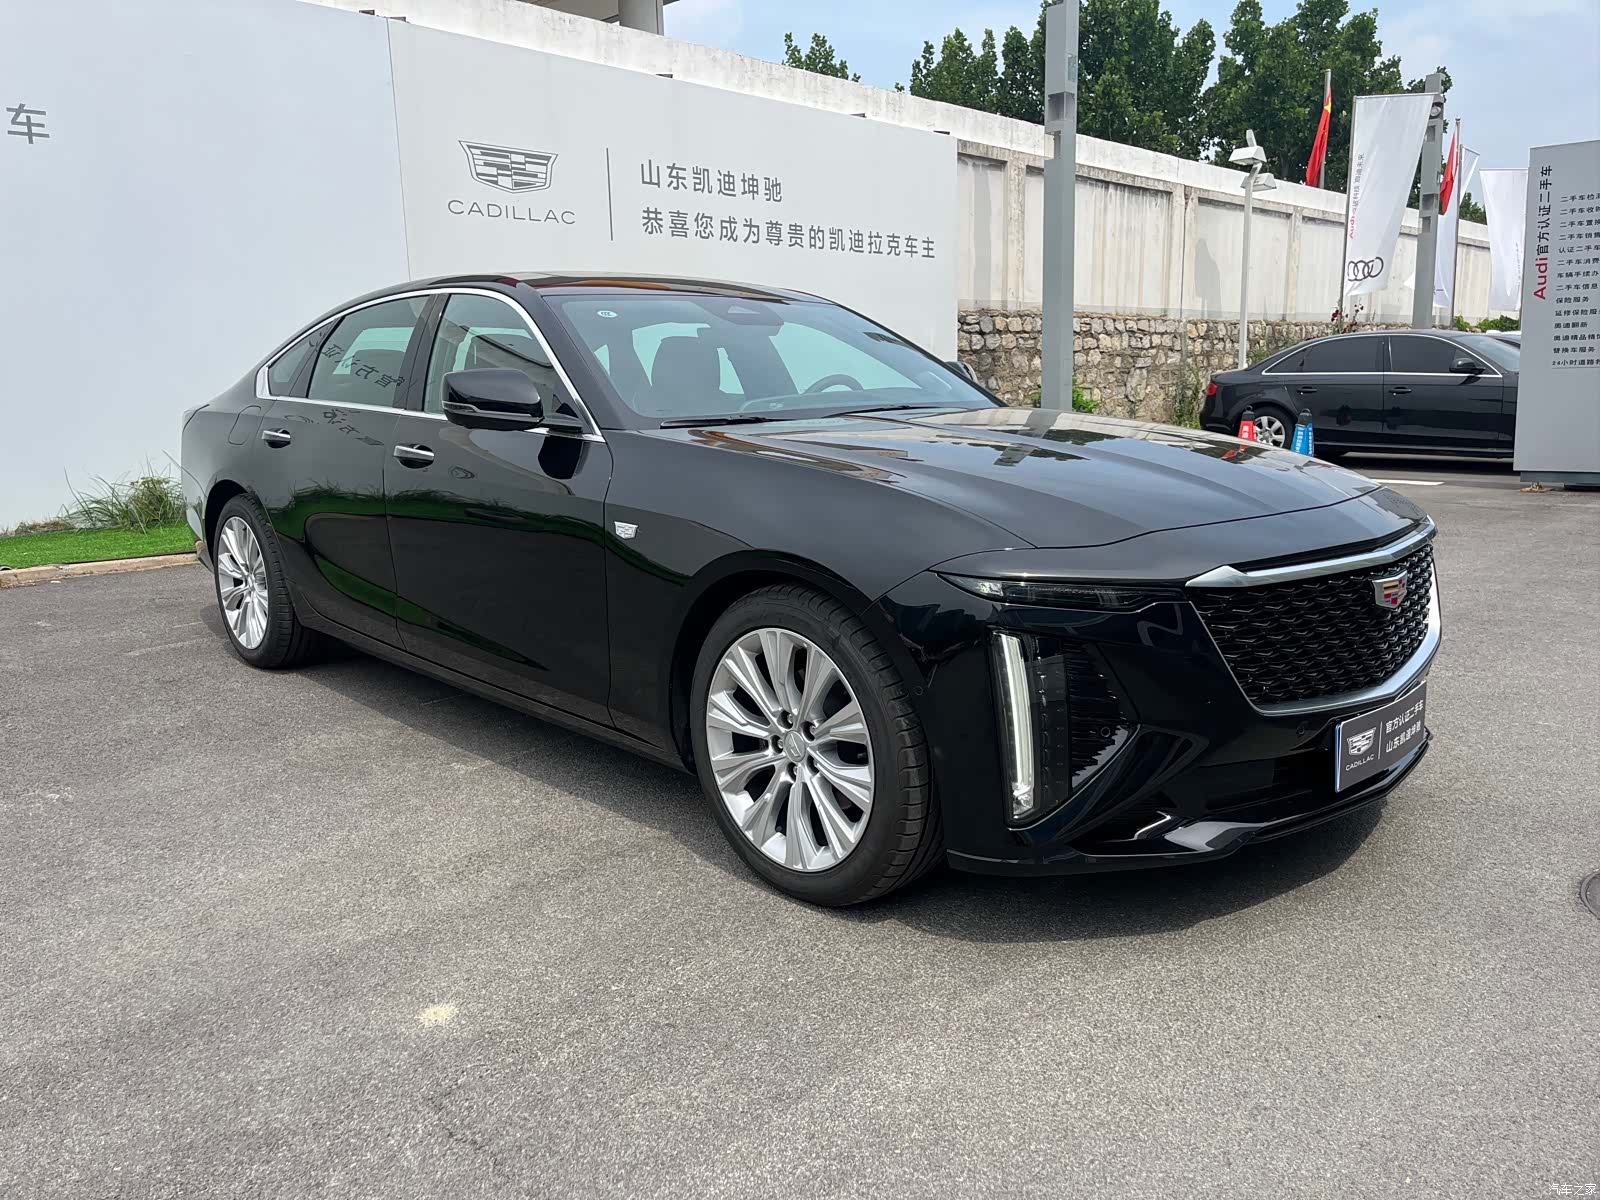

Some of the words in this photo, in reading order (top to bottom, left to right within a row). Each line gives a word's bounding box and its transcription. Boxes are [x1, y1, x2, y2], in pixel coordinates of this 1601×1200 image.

[6, 103, 50, 144] 车
[640, 159, 782, 203] 山东凯迪坤驰
[447, 199, 576, 225] CADILLAC
[642, 207, 936, 259] 恭喜您成为尊贵的凯迪拉克车主
[1555, 283, 1598, 291] 二手车信息
[1556, 296, 1589, 304] 保险服务
[1555, 308, 1600, 316] 延修保险服
[1553, 346, 1595, 354] 替换车服务
[1345, 753, 1375, 771] CADILLAC
